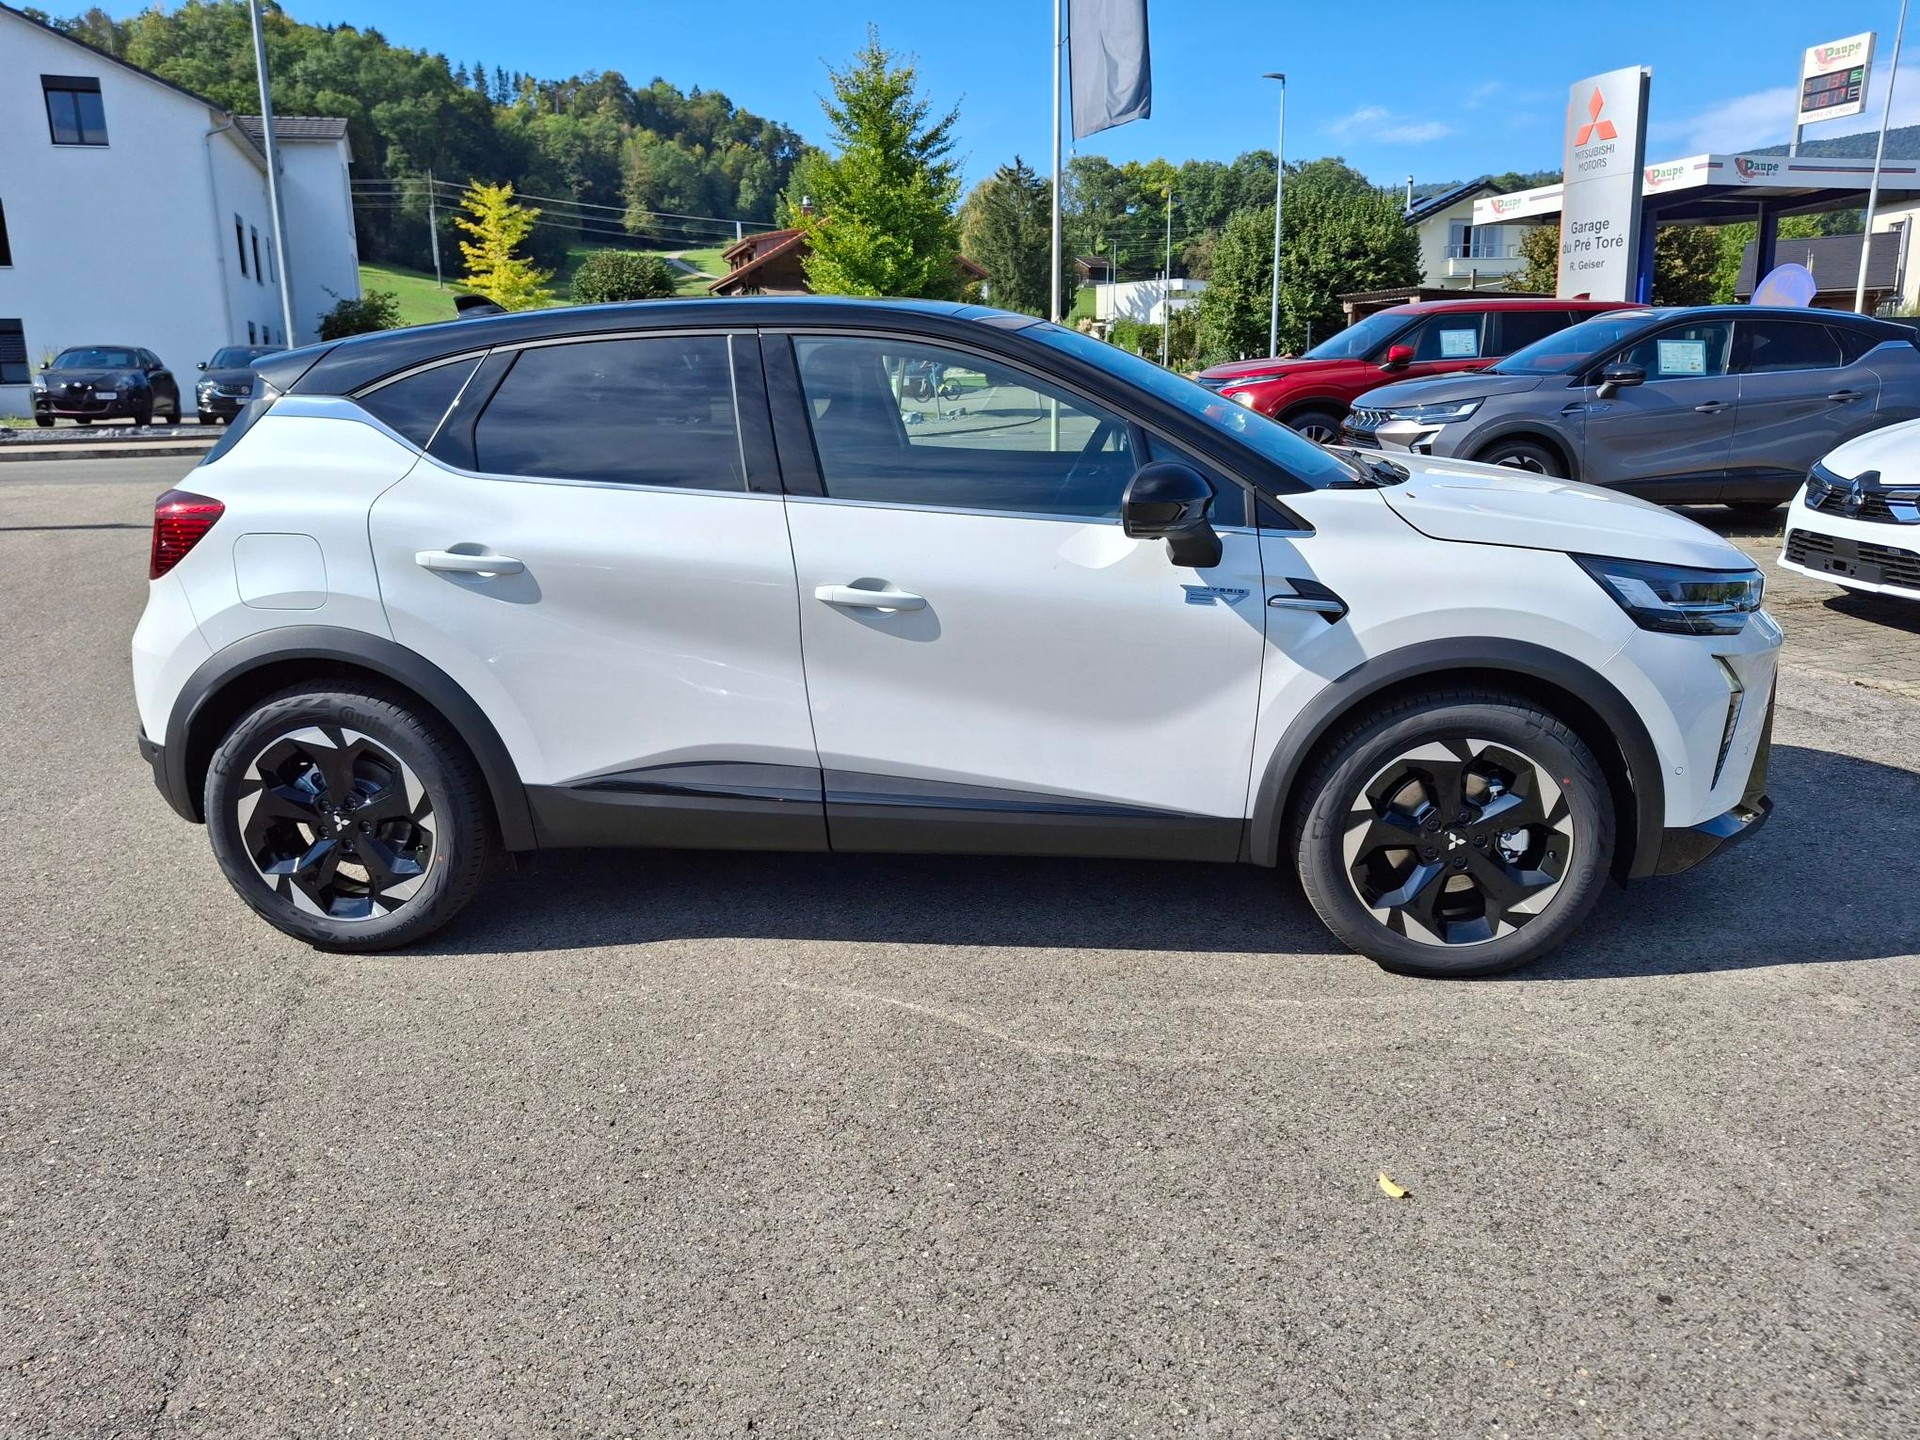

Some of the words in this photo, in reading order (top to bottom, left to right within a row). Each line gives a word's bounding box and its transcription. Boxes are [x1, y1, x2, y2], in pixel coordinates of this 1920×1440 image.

[1825, 42, 1862, 58] Paupe
[1574, 144, 1615, 160] MITSUBISHI
[1578, 157, 1607, 172] MOTORS
[1745, 159, 1779, 176] Paupe
[1652, 166, 1684, 181] Paupe
[1571, 219, 1610, 234] Garage
[1562, 242, 1572, 254] du
[1574, 237, 1591, 252] Pré
[1594, 234, 1624, 249] Toré
[1569, 262, 1576, 271] R.
[1578, 260, 1605, 271] Geiser
[1203, 586, 1245, 594] HYBRID
